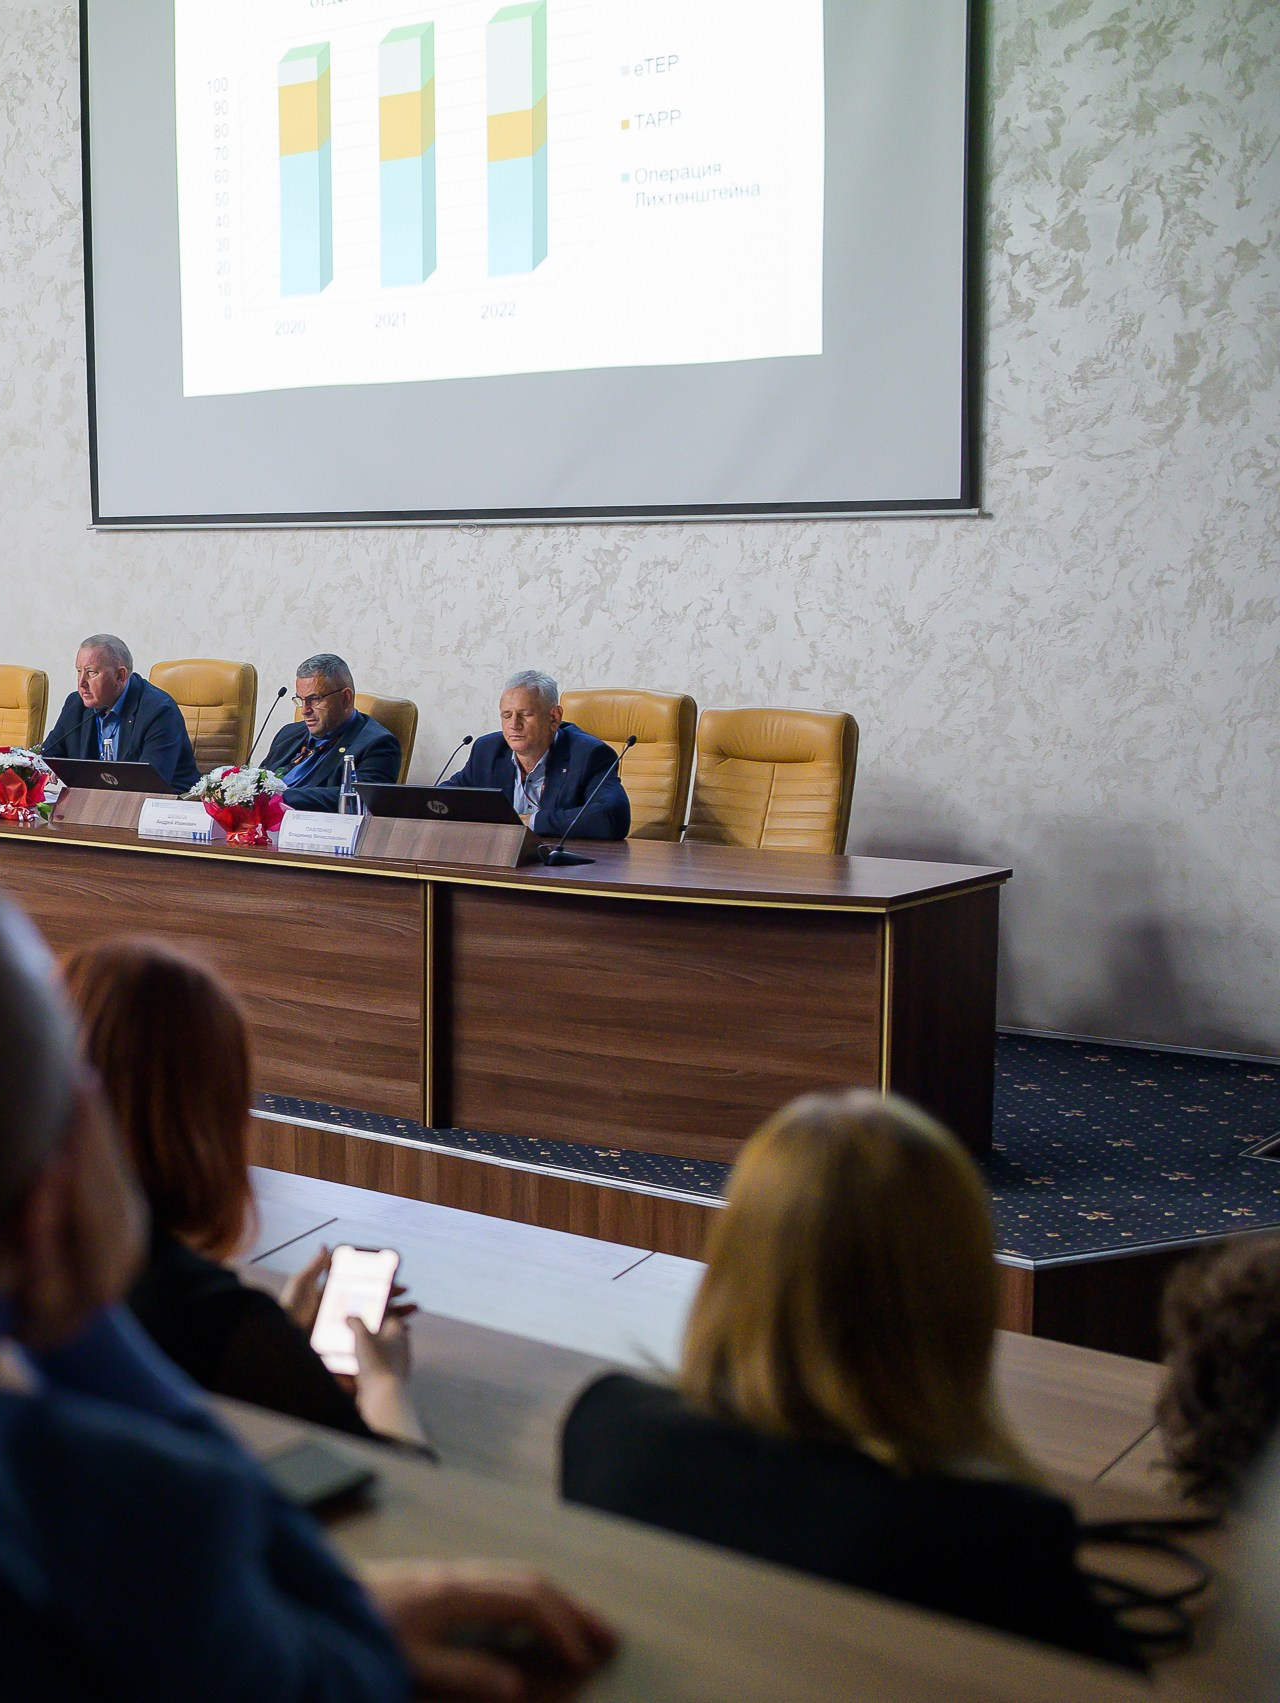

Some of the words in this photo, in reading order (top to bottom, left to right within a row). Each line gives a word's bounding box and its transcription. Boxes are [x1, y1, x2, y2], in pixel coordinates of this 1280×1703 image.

[634, 54, 679, 76] eTEP
[207, 78, 228, 93] 100
[213, 100, 229, 116] 90
[634, 109, 681, 130] TAPP
[214, 123, 229, 138] 80
[214, 146, 229, 161] 70
[214, 169, 230, 184] 60
[634, 163, 722, 184] Операция
[215, 191, 230, 206] 50
[634, 183, 761, 208] Лихтенштейна
[215, 214, 230, 229] 40
[215, 237, 230, 252] 30
[216, 260, 231, 275] 20
[217, 283, 231, 298] 10
[481, 302, 517, 320] 2022
[274, 319, 306, 336] 2020
[375, 312, 406, 329] 2021
[427, 800, 448, 814] hp
